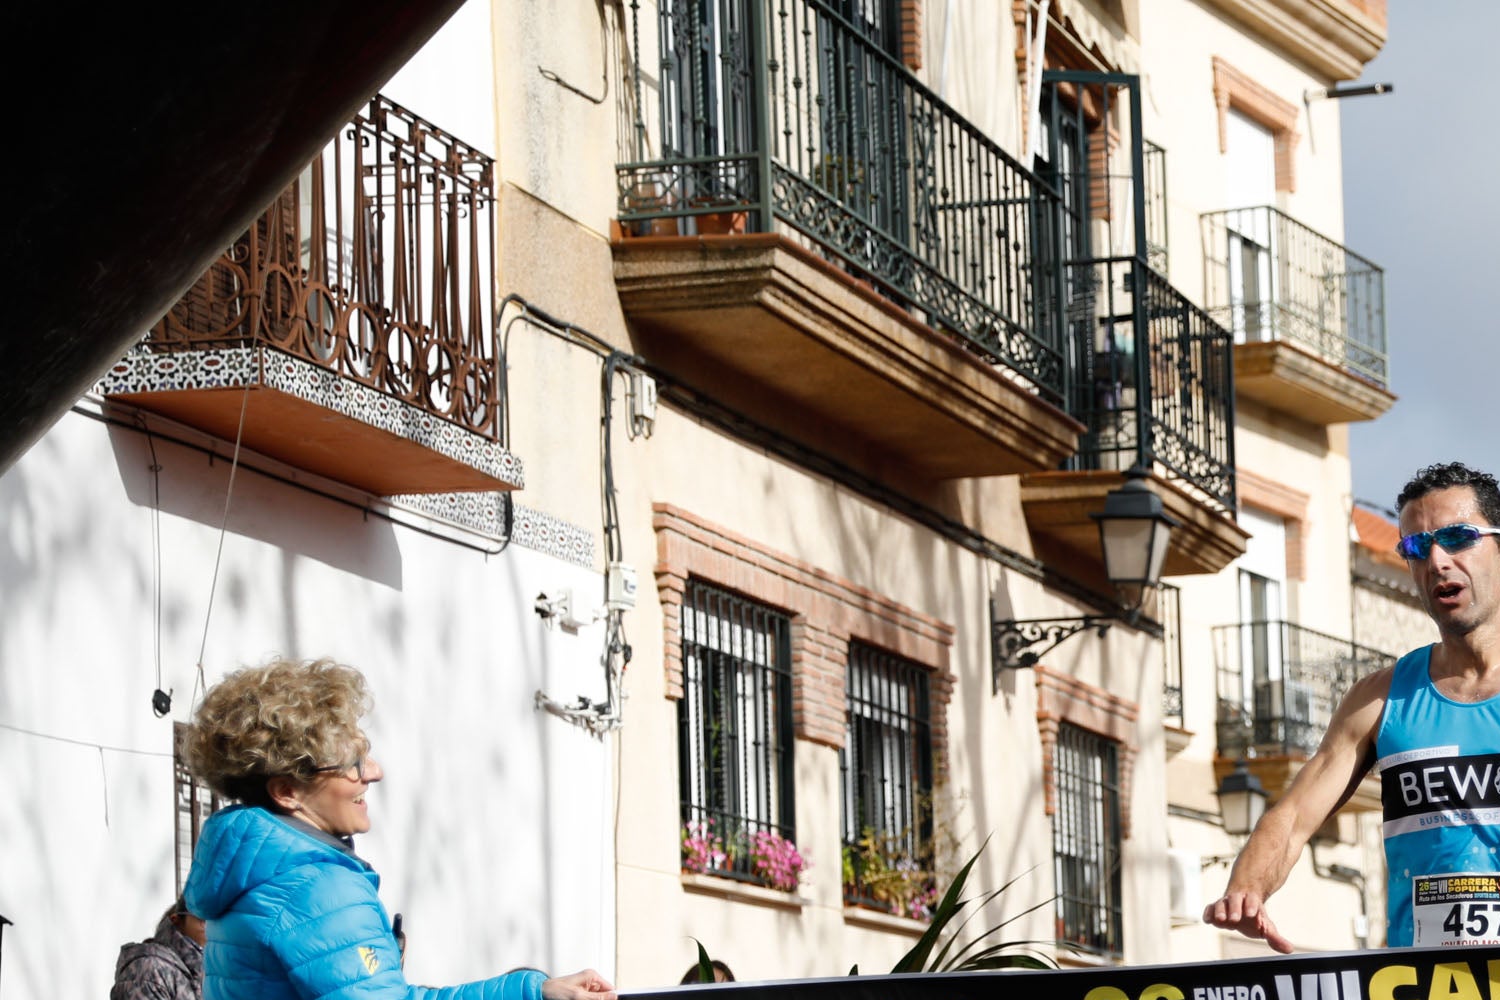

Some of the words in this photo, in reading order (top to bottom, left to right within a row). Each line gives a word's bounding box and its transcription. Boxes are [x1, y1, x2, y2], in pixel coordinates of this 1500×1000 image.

[1418, 882, 1430, 891] 26
[1448, 878, 1497, 887] CARRERA
[1448, 885, 1497, 893] POPULAR
